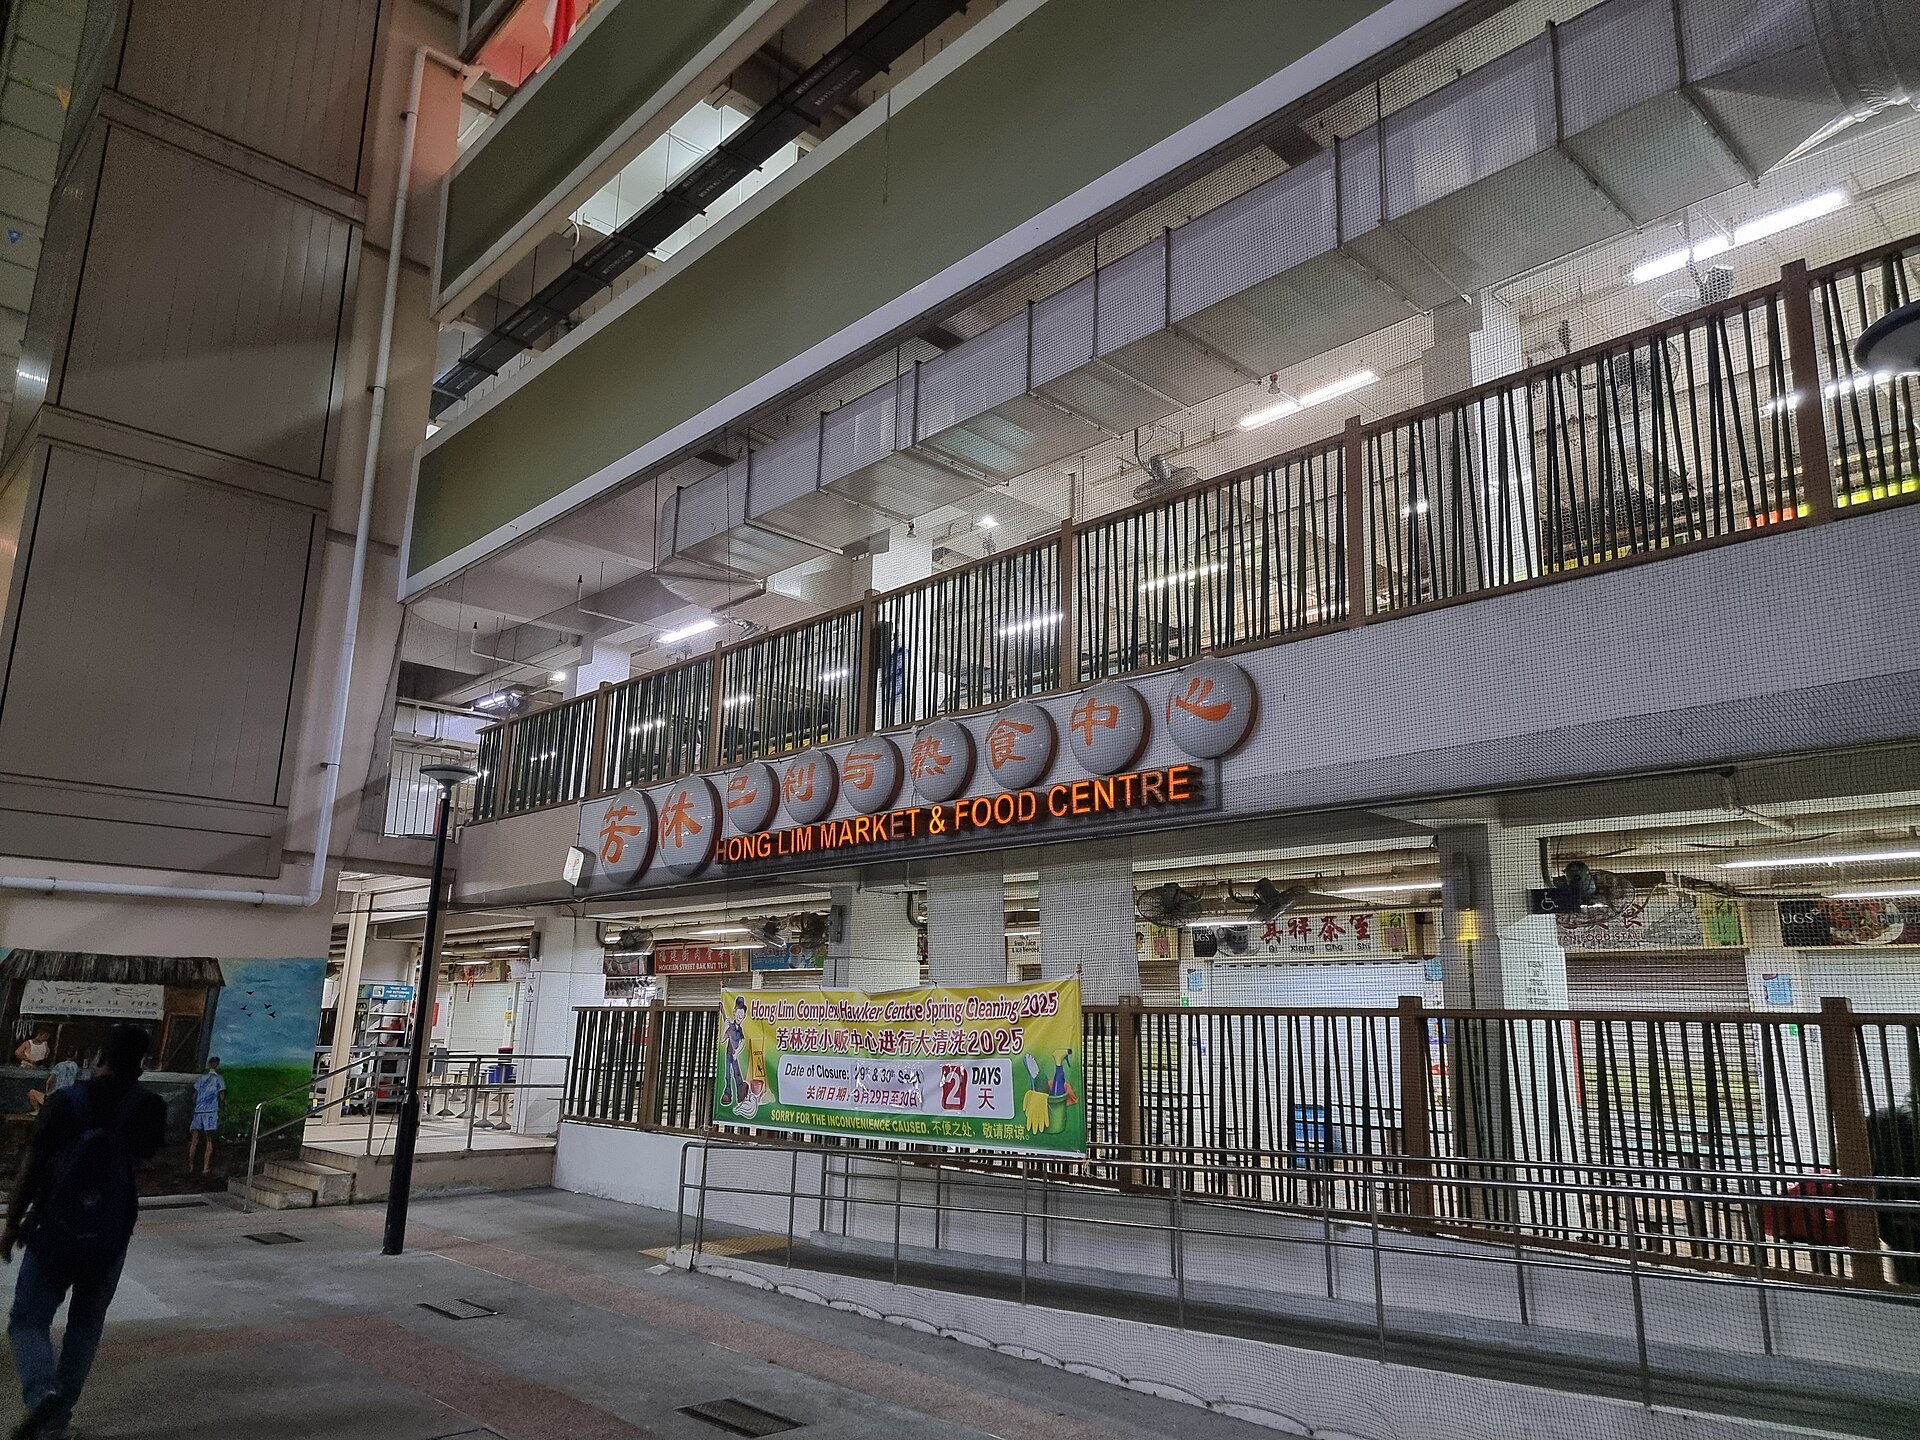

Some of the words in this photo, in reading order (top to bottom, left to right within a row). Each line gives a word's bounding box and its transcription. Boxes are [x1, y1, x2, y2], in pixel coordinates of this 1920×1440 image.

[714, 832, 771, 865] HONG
[778, 825, 813, 855] LIM
[820, 808, 921, 849] MARKET
[929, 805, 946, 835] &
[954, 790, 1037, 830] FOOD
[1048, 764, 1191, 818] CENTRE
[1781, 912, 1814, 925] UGS
[1193, 934, 1210, 942] UGS
[1289, 943, 1315, 952] Xiang
[658, 963, 679, 971] HOKKIEN
[679, 963, 696, 971] STREET
[751, 1000, 775, 1023] Hong
[777, 1000, 794, 1020] Lim
[796, 999, 839, 1024] Complex
[839, 1001, 883, 1021] Hawker
[884, 1000, 923, 1020] Centre
[925, 997, 963, 1024] Spring
[965, 994, 1020, 1023] Cleaning
[1020, 991, 1058, 1016] 2025
[776, 1027, 1024, 1056] 芳林苑小贩中心进行大清洗2025
[784, 1062, 804, 1077] Date
[807, 1064, 815, 1078] of
[816, 1064, 850, 1080] Closure:
[872, 1067, 879, 1082] &
[971, 1066, 1001, 1086] DAYS
[978, 1087, 995, 1110] 天
[771, 1109, 795, 1122] SORRY
[796, 1111, 810, 1123] FOR
[811, 1113, 826, 1125] THE
[827, 1115, 891, 1130] INCONVENIENCE
[892, 1119, 930, 1134] CAUSED.
